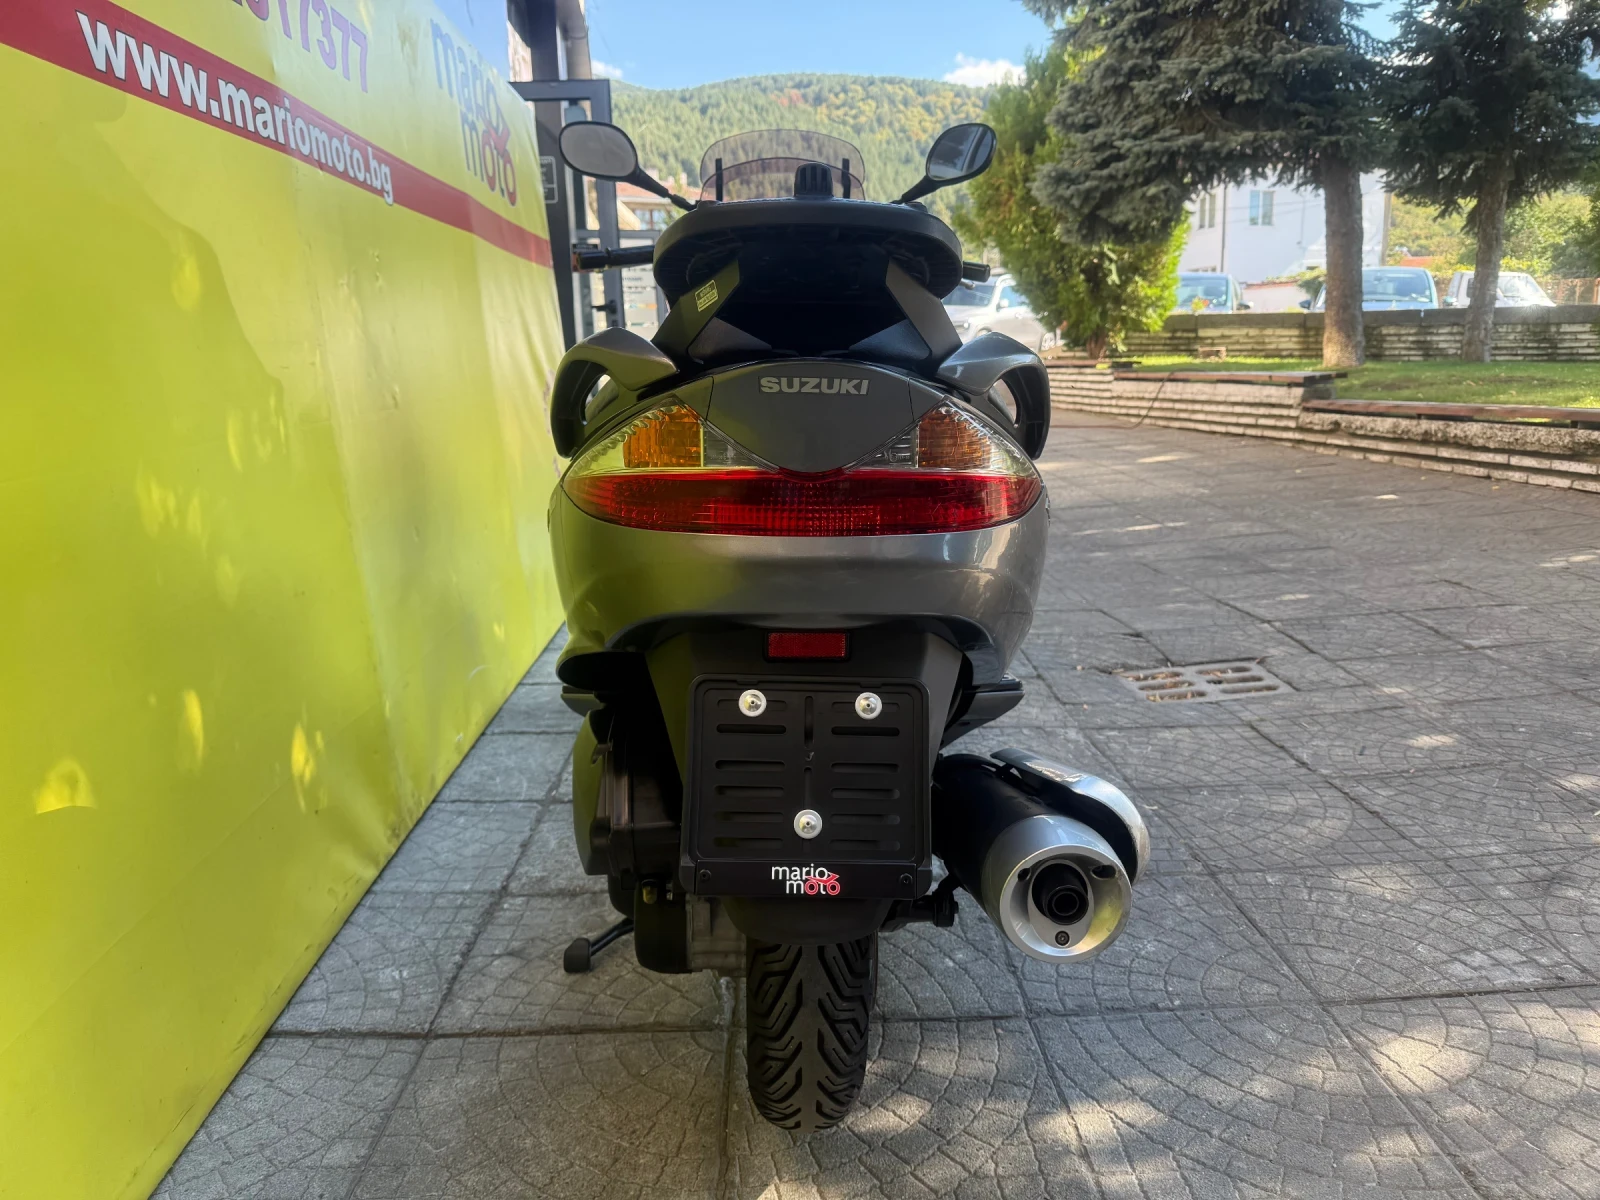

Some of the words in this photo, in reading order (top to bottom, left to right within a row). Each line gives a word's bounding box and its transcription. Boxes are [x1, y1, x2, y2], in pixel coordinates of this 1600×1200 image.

[430, 18, 501, 132] mario
[75, 9, 394, 206] www.mariomoto.bg
[459, 108, 517, 207] moto
[760, 376, 869, 395] SUZUKI
[771, 863, 829, 880] mario
[786, 879, 840, 896] moto
